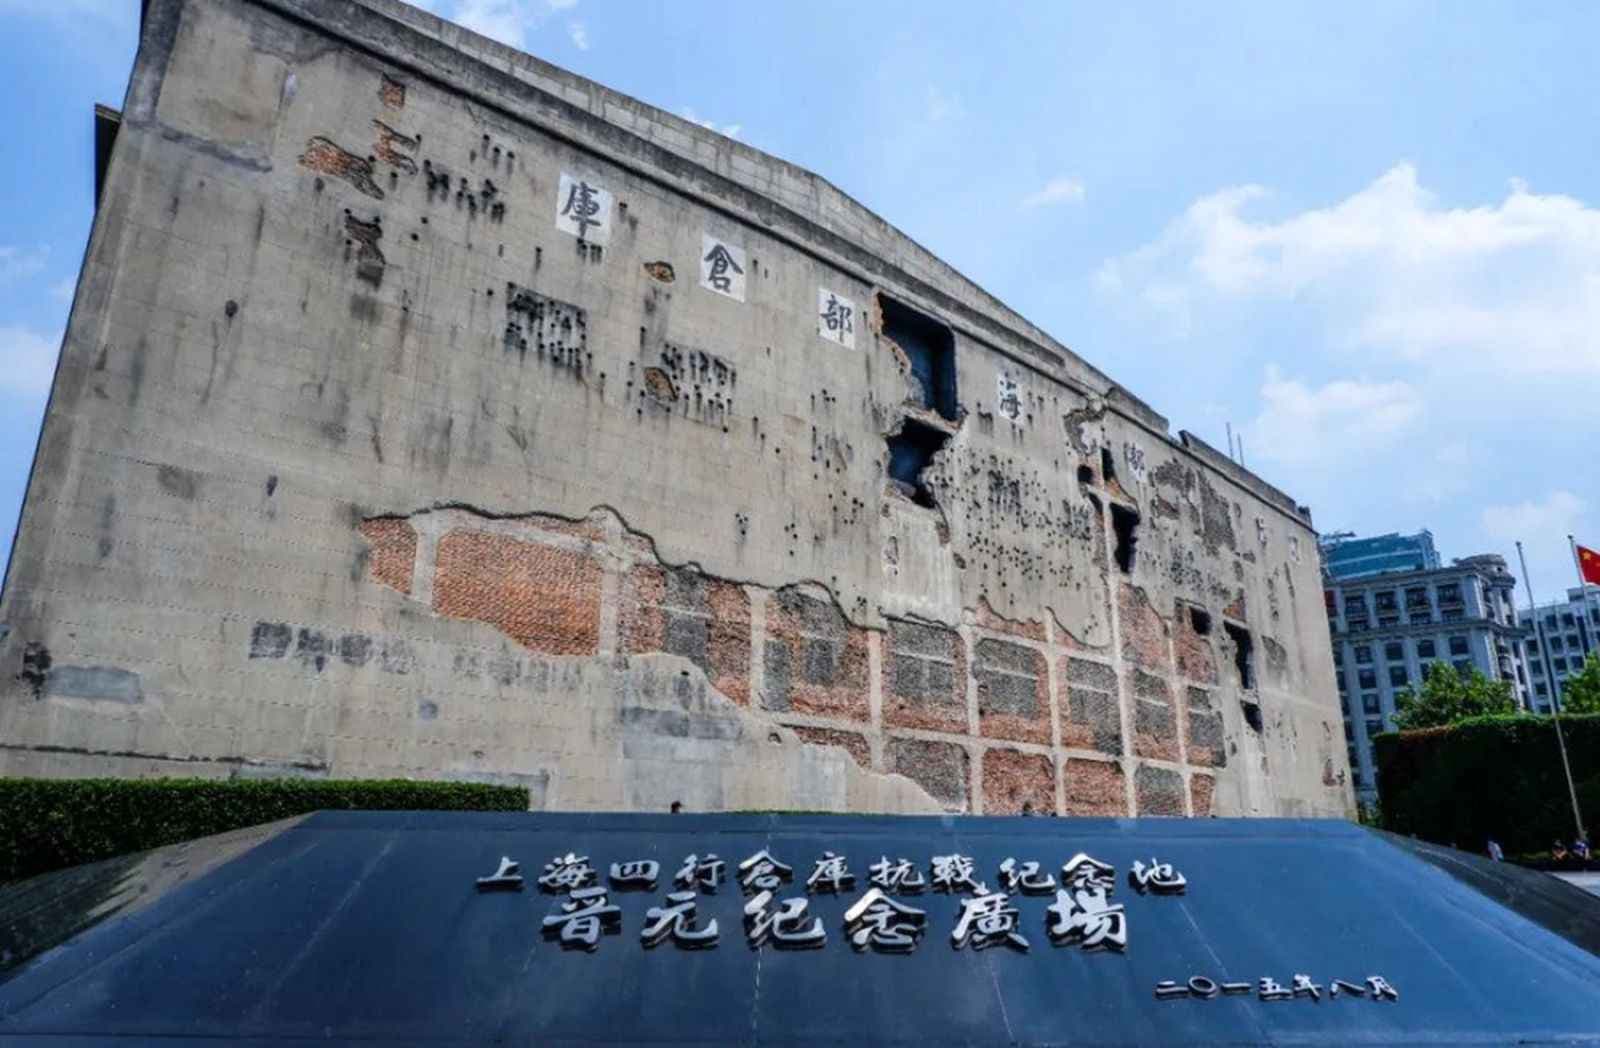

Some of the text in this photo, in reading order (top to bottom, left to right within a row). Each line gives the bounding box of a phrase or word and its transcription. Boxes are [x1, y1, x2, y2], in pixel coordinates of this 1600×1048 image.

[560, 180, 603, 239] 庫
[703, 242, 744, 294] 倉
[819, 293, 854, 346] 部
